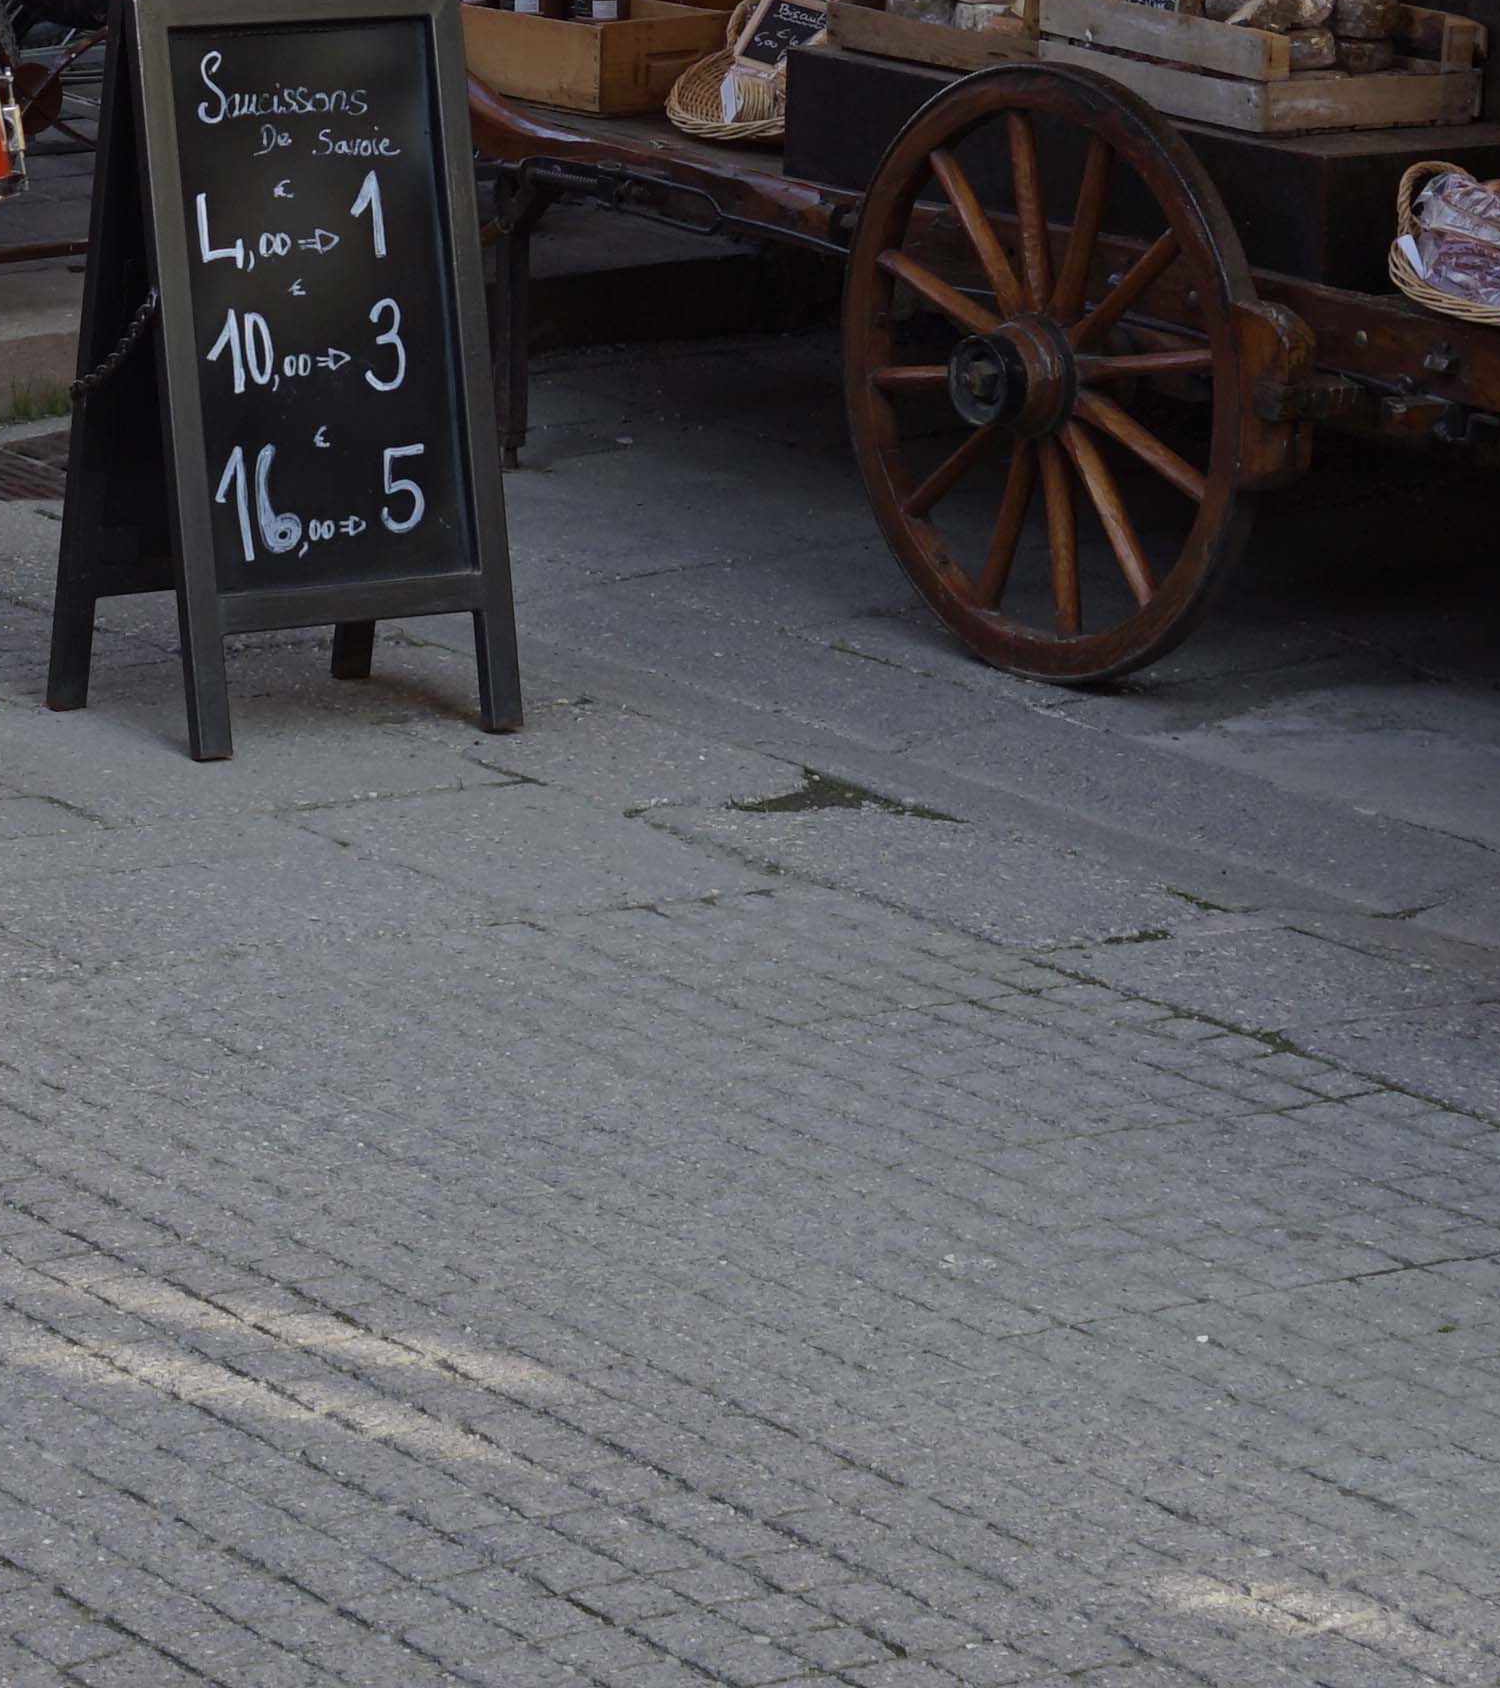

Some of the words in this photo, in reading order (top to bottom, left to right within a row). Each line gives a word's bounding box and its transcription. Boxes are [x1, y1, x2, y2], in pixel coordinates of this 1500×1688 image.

[197, 49, 369, 125] Saucissons
[252, 123, 293, 157] De
[311, 127, 401, 158] Savoie
[195, 191, 291, 272] 4,00
[350, 169, 387, 258] 1
[206, 308, 311, 394] 10,00
[364, 296, 407, 393] 3
[215, 443, 336, 562] 16,00
[381, 443, 426, 533] 5
